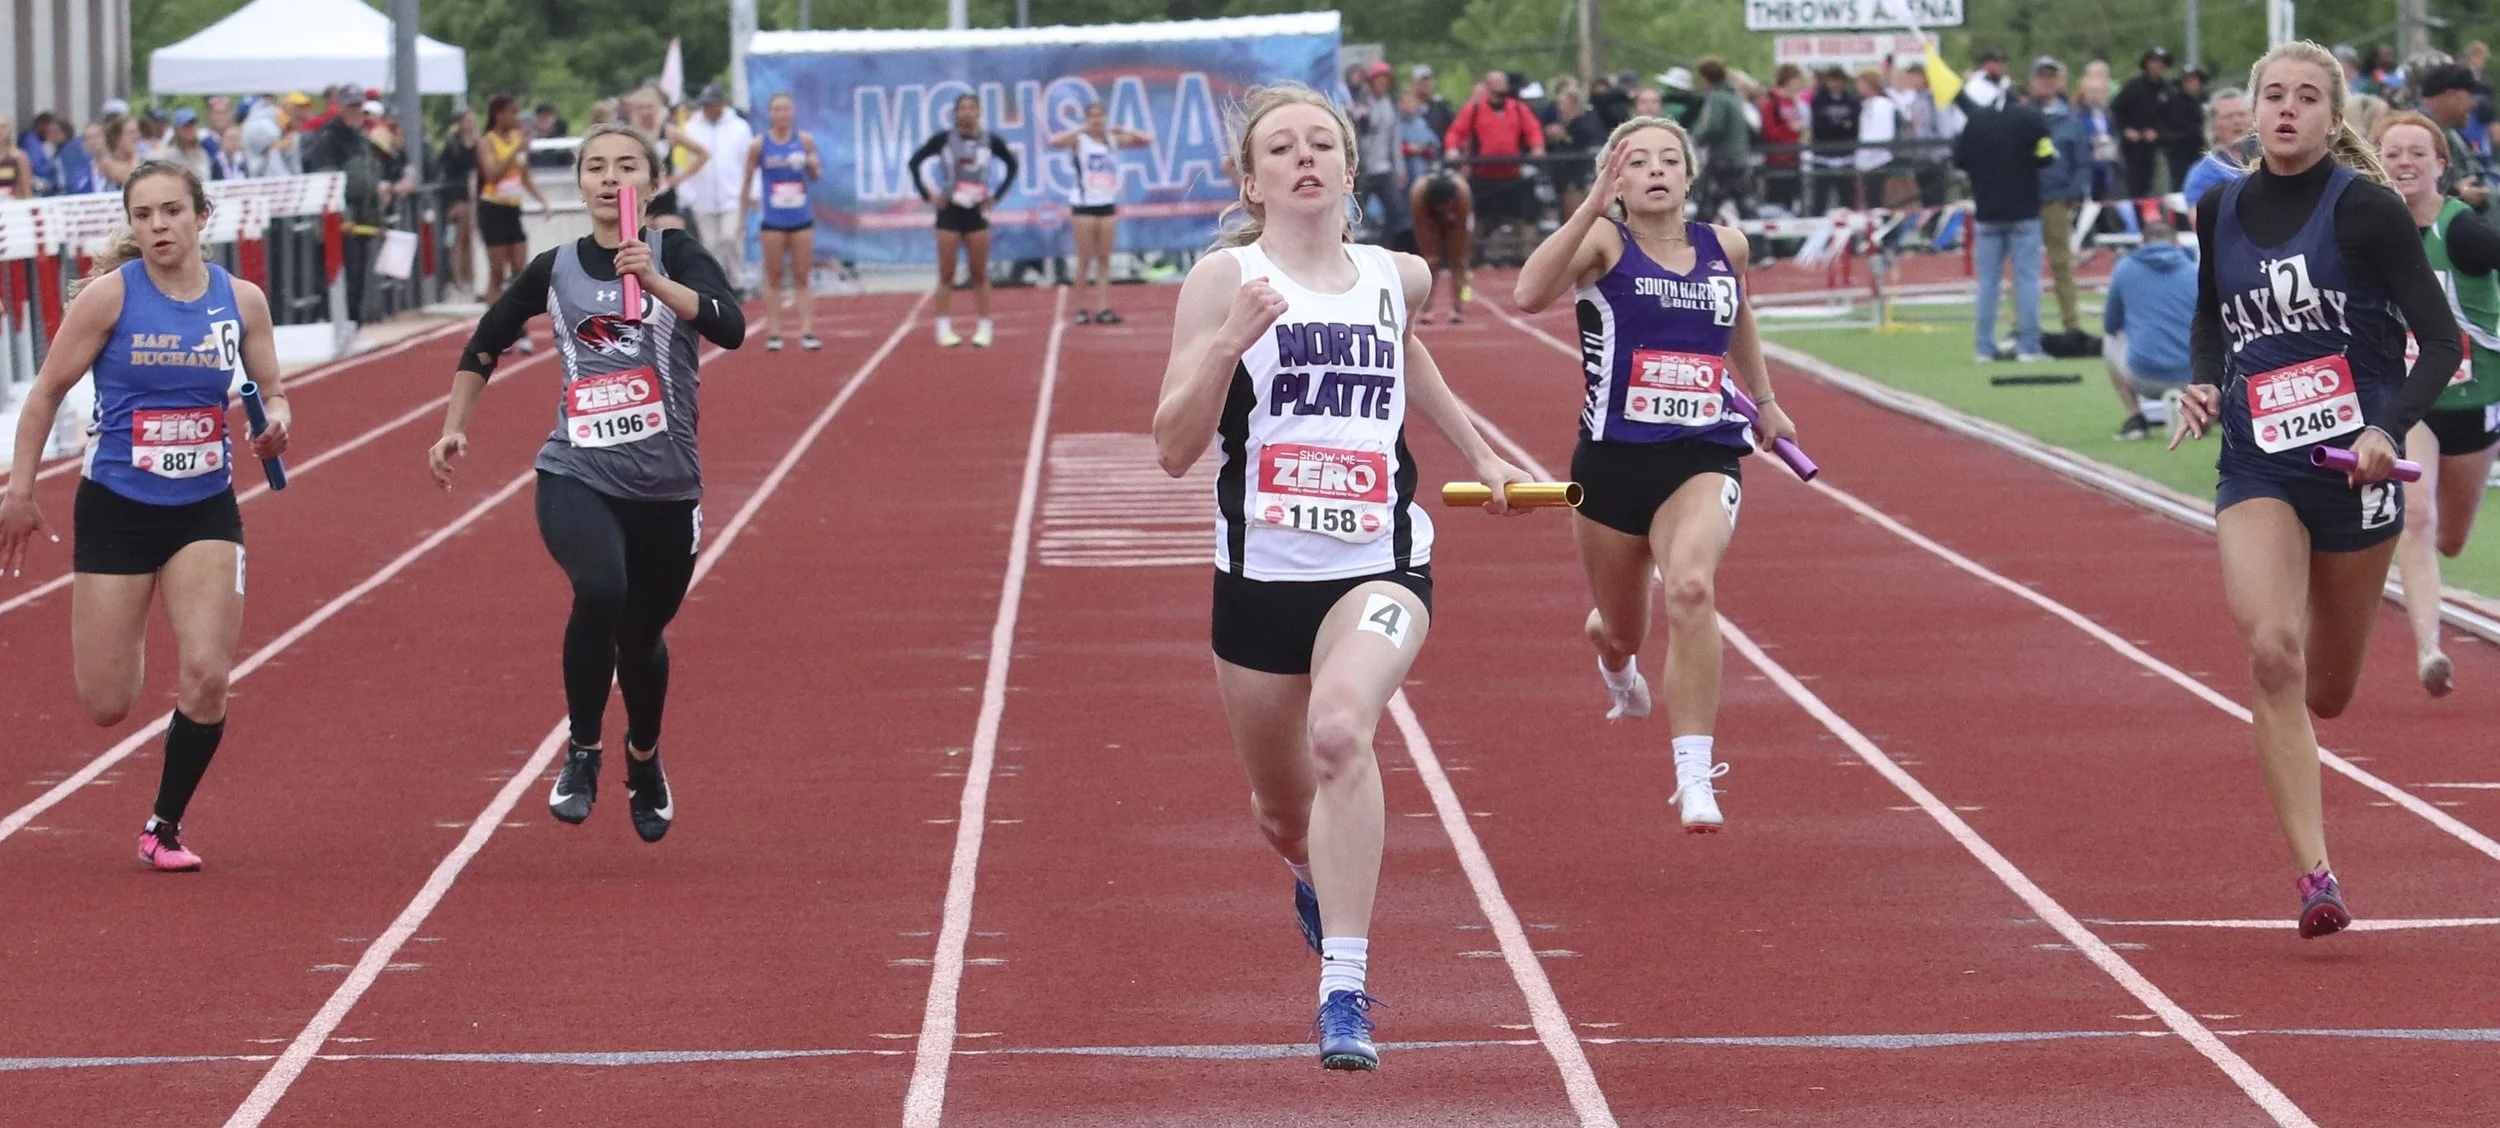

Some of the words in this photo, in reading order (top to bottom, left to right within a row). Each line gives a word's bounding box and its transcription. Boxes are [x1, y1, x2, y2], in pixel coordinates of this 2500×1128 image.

[1753, 1, 1858, 23] THROWS
[1634, 277, 1678, 298] SOUTH
[1717, 279, 1733, 323] 3
[2277, 262, 2312, 310] 2
[1378, 287, 1399, 341] 4
[131, 333, 182, 349] EAST
[222, 323, 236, 367] 6
[1275, 322, 1395, 370] NORTH
[1640, 361, 1714, 388] ZERO
[2256, 369, 2340, 410] ZERO
[575, 379, 650, 411] ZERO
[1270, 372, 1395, 420] PLATTE
[1652, 396, 1699, 418] 1301
[142, 417, 215, 442] ZERO
[593, 414, 643, 439] 1196
[2279, 408, 2336, 440] 1246
[163, 451, 197, 471] 887
[1300, 450, 1357, 465] SHOW-ME
[1272, 458, 1377, 494] ZERO
[1289, 504, 1357, 533] 1158
[2370, 482, 2391, 525] 2
[1369, 603, 1402, 637] 4
